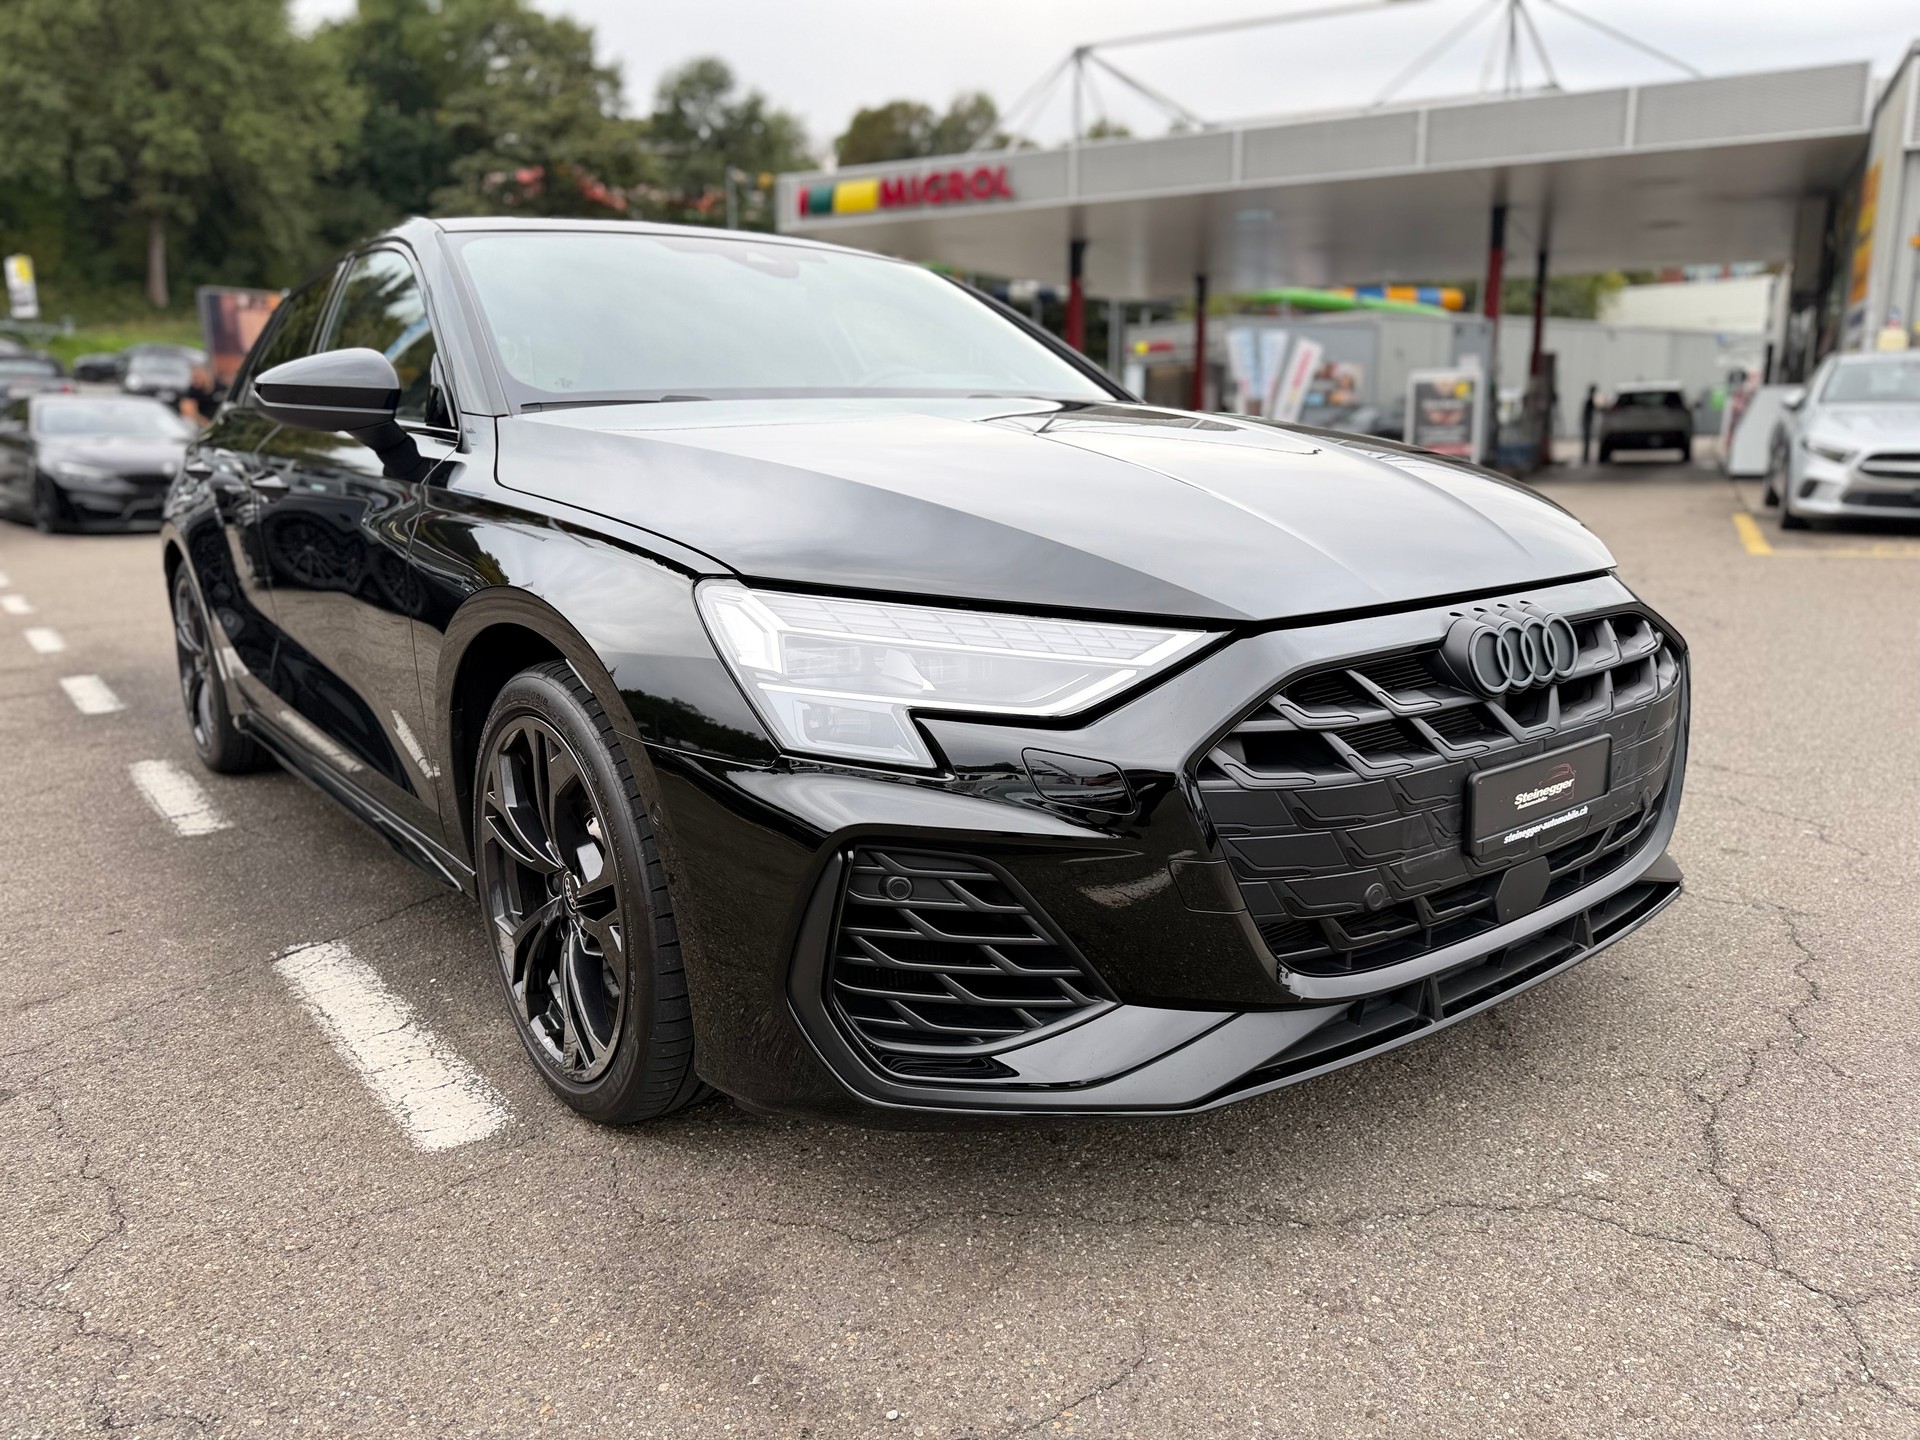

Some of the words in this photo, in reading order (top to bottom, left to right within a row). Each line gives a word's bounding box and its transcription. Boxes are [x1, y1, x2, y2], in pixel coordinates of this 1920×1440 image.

[879, 165, 1013, 208] MIGROL
[1514, 778, 1575, 805] Steinegger
[1503, 805, 1589, 844] steinegger-automobile.ch
